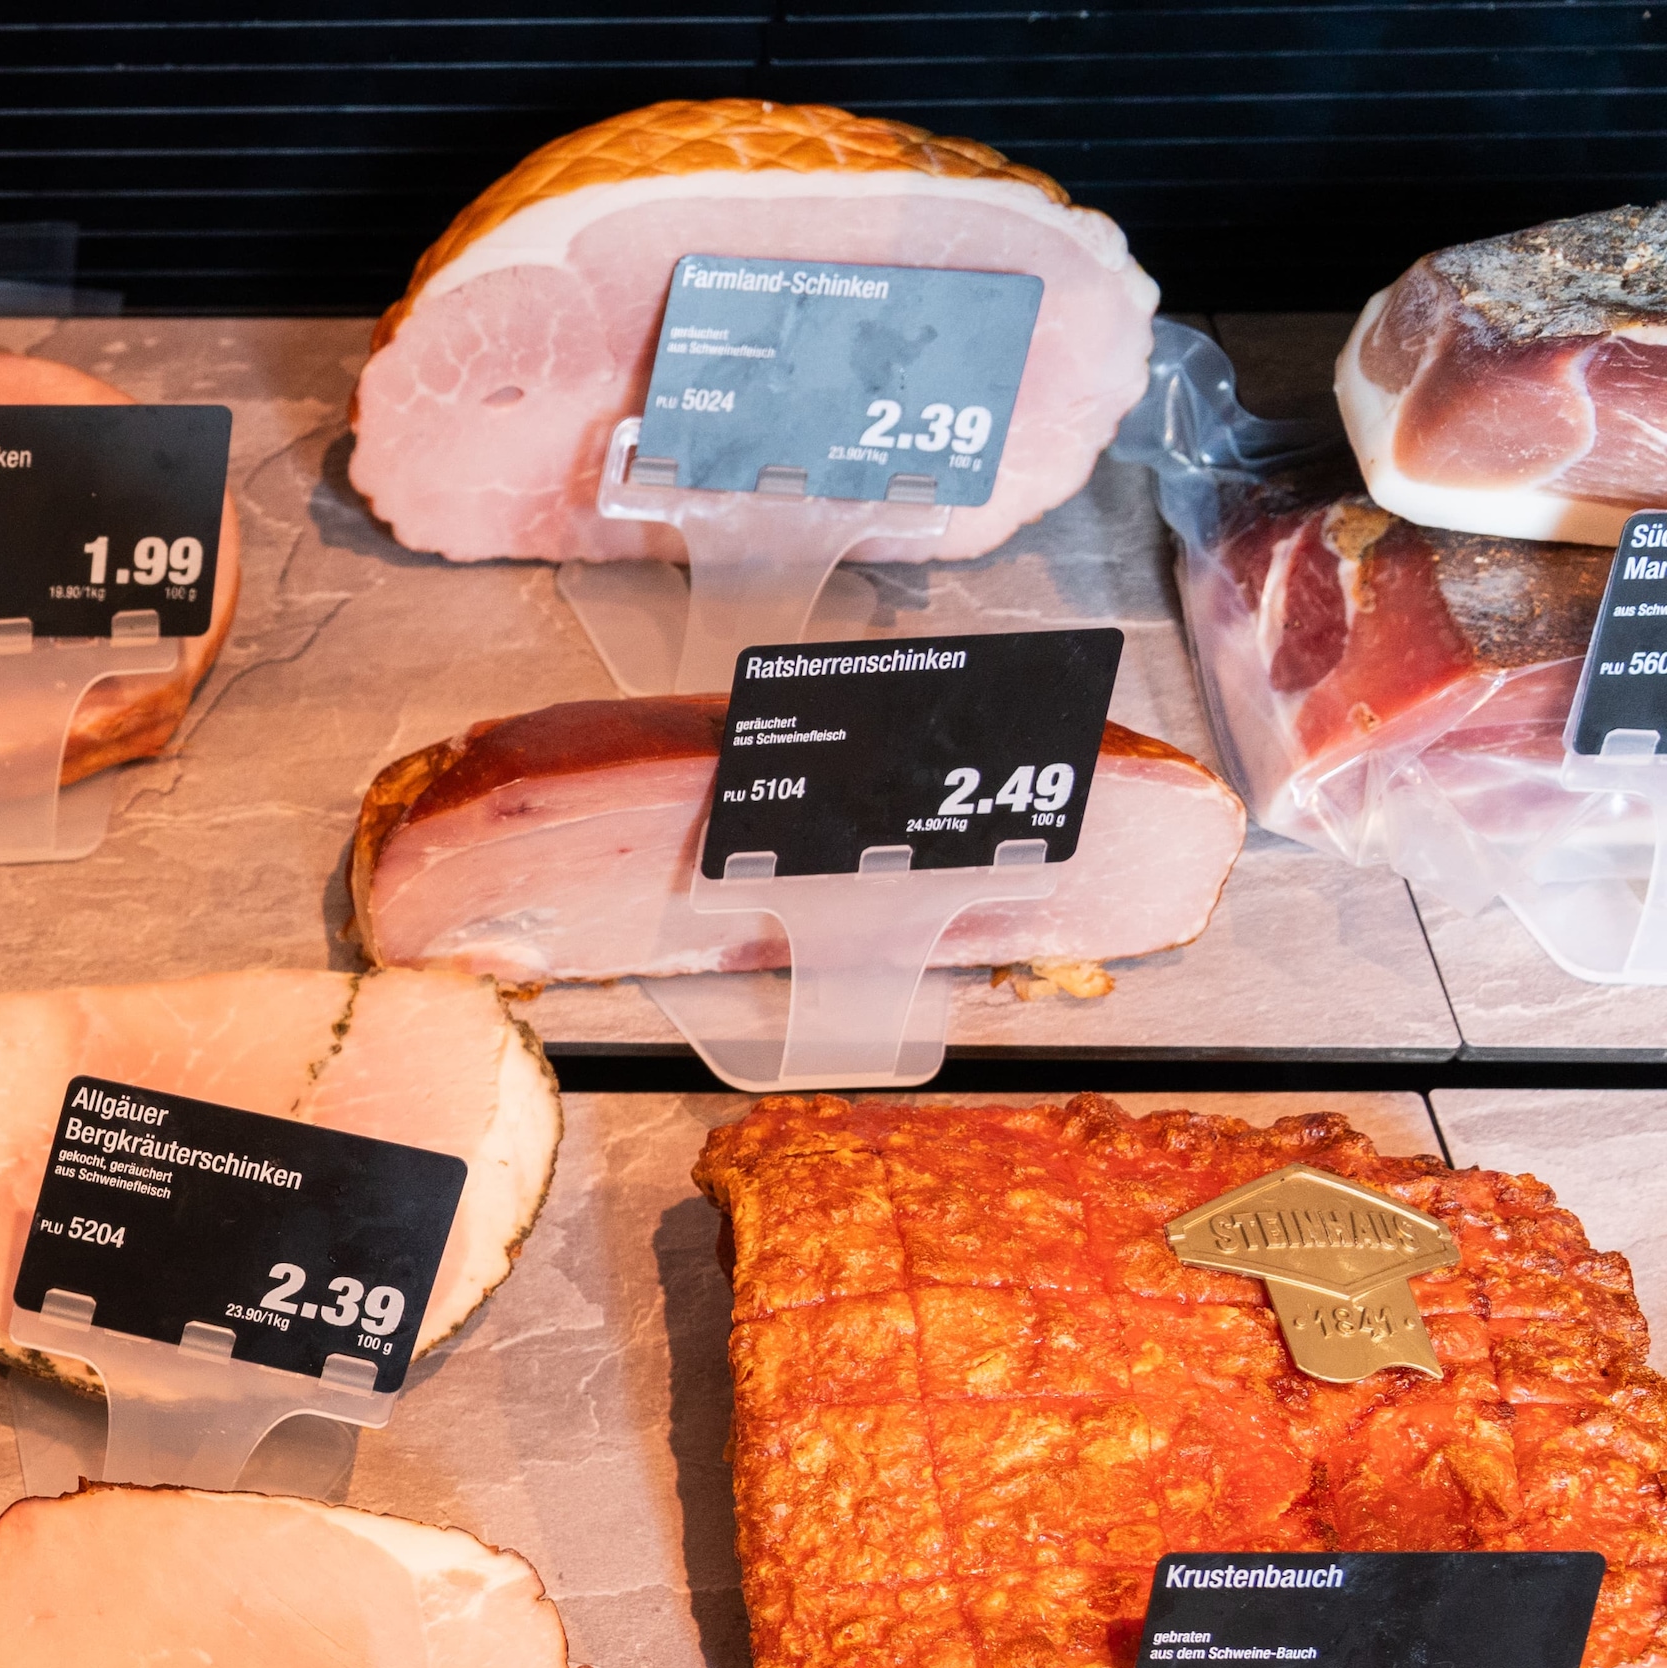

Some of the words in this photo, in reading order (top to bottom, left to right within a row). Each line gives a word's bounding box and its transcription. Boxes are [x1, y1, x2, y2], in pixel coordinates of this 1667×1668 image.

[681, 264, 889, 300] Farmland-Schinken
[681, 388, 735, 413] 5024
[859, 399, 993, 455] 2.39
[84, 536, 203, 585] 1.99
[745, 647, 967, 680] Ratsherrenschinken
[750, 776, 806, 802] 5104
[937, 762, 1075, 816] 2.49
[71, 1087, 169, 1127] Allgäuer
[58, 1149, 107, 1171] gekocht,
[110, 1159, 173, 1183] geräuchert
[65, 1117, 303, 1190] Bergkräuterschinken
[54, 1164, 76, 1178] aus
[78, 1166, 171, 1199] Schweinefleisch
[68, 1216, 126, 1249] 5204
[1209, 1209, 1421, 1255] STEINHAUS
[259, 1262, 405, 1336] 2.39
[225, 1303, 291, 1332] 23.90/1kg
[1313, 1306, 1396, 1343] 1841
[1165, 1563, 1344, 1589] Krustenbauch
[1149, 1649, 1174, 1660] aus
[1176, 1646, 1206, 1660] dem
[1207, 1646, 1317, 1660] Schweine-Bauch
[1152, 1630, 1212, 1646] gebraten
